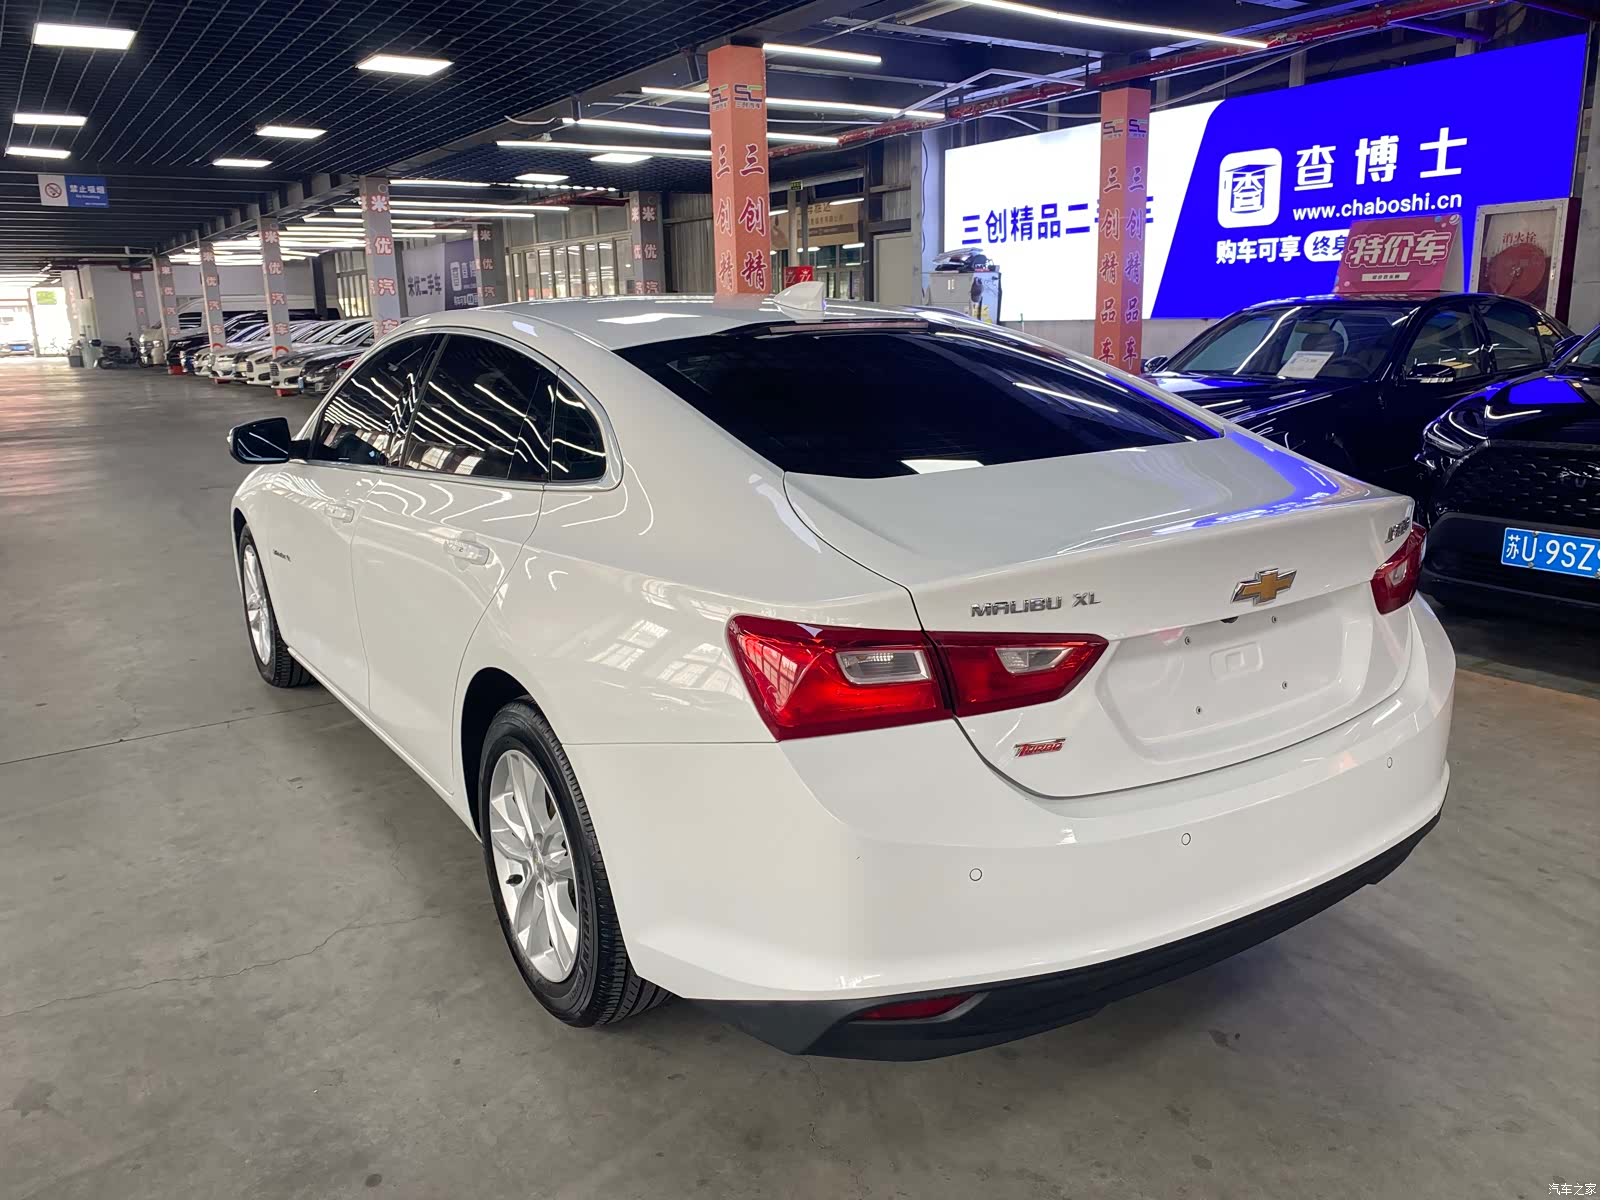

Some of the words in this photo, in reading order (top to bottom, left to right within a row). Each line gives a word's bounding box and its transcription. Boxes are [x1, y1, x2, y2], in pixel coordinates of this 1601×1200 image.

[1294, 127, 1467, 192] 查博士
[739, 143, 768, 292] 三创精
[1293, 192, 1462, 221] www.chaboshi.cn
[1216, 235, 1302, 265] 购车可享
[1349, 232, 1451, 266] 特价车
[1123, 166, 1146, 370] 三创精品车
[971, 596, 1062, 617] MALIBU
[1072, 592, 1102, 607] XL
